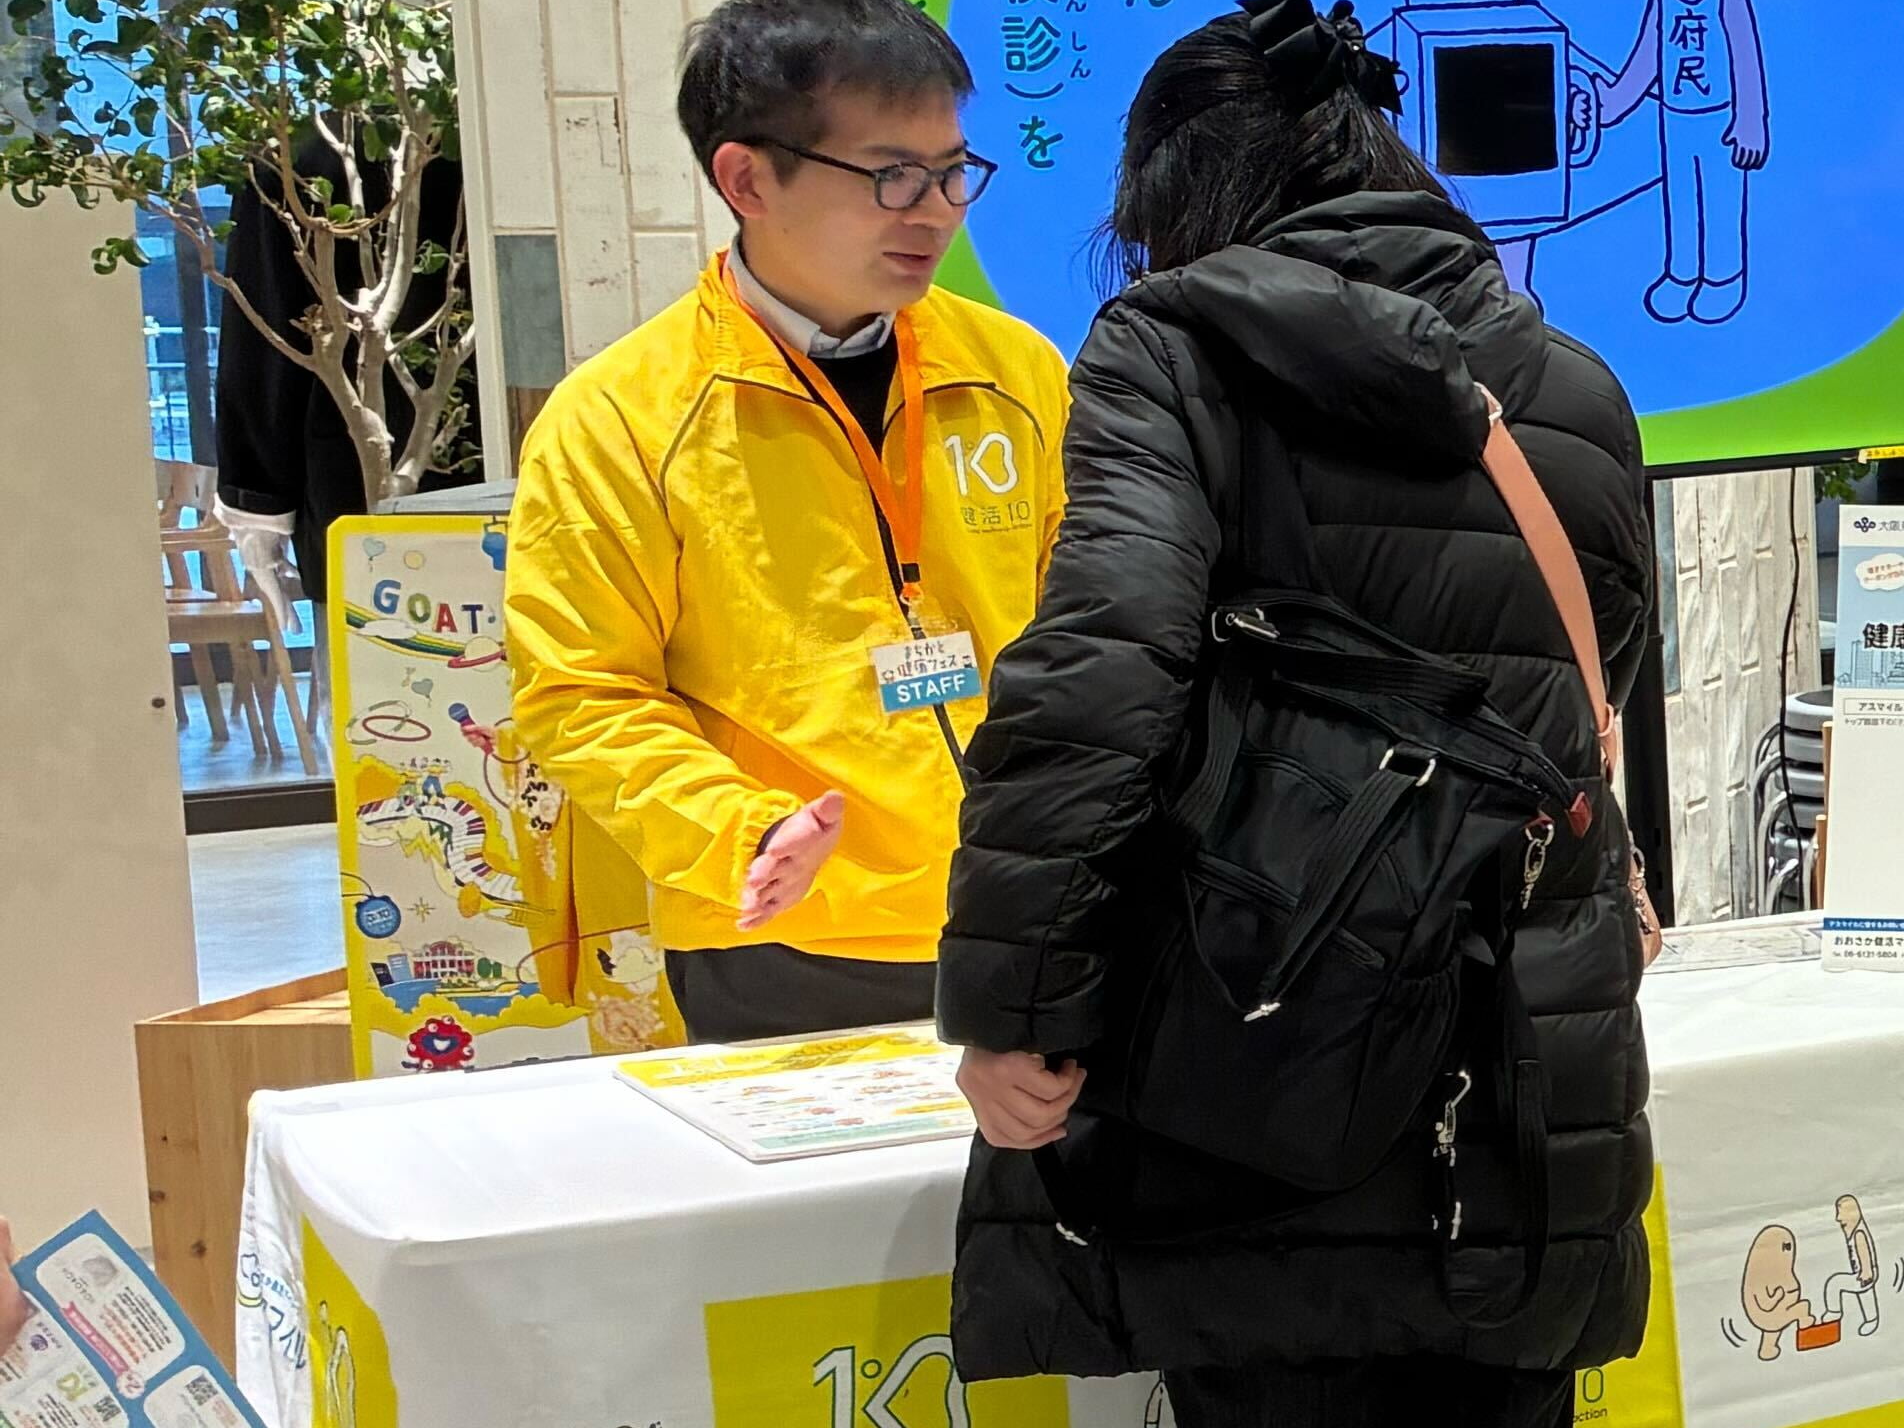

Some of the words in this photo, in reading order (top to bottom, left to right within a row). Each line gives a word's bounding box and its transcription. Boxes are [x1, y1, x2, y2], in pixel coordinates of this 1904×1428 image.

[1069, 33, 1092, 81] しん
[1669, 8, 1711, 96] 府民
[373, 579, 484, 634] GOAT
[896, 674, 966, 703] STAFF
